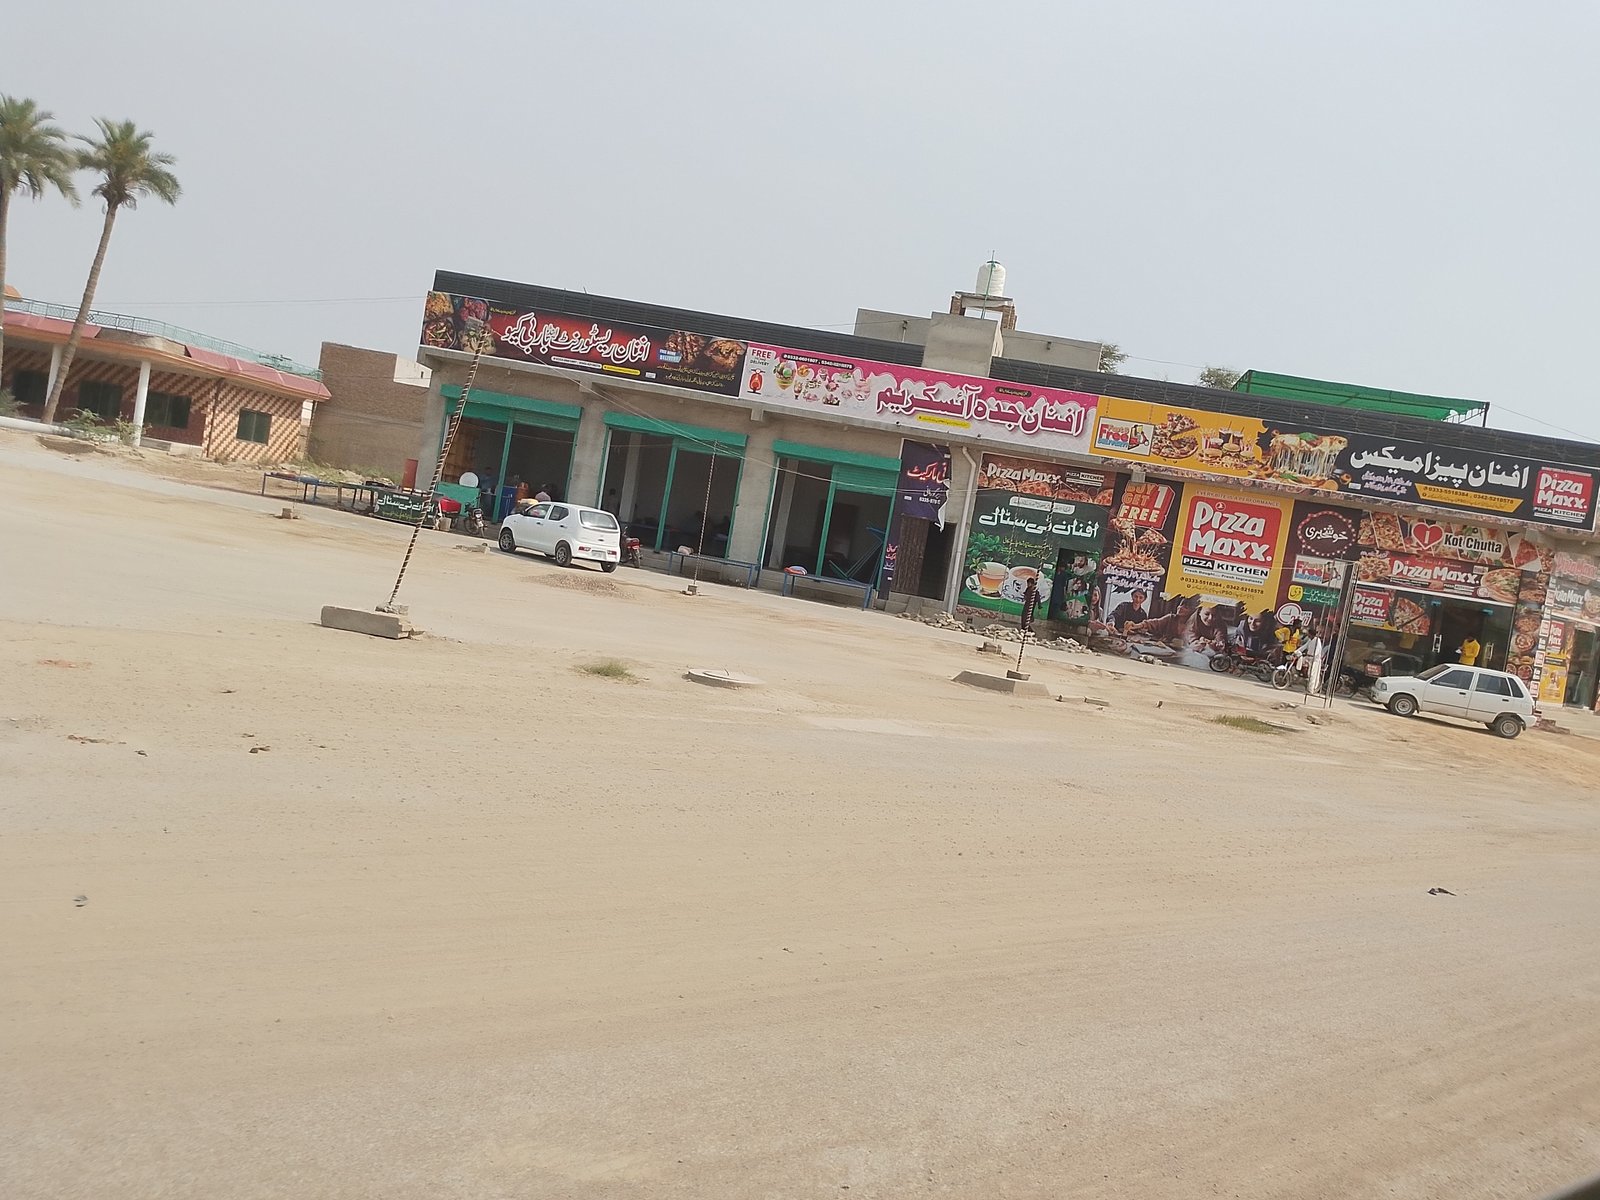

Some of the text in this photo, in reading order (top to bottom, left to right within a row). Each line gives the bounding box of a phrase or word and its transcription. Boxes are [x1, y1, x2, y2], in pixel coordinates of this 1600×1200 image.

[611, 336, 650, 364] افنان
[752, 349, 772, 359] FREE
[1020, 402, 1085, 437] افنان
[987, 462, 1020, 481] Pizza
[1080, 473, 1104, 481] KITCHEN
[1468, 461, 1529, 489] افنان
[1539, 473, 1583, 494] Pizza
[1123, 492, 1150, 507] GET
[1127, 483, 1168, 509] BUY 1
[1119, 505, 1160, 522] FREE
[1193, 501, 1265, 537] Pizza
[1554, 510, 1586, 519] KITCHEN
[1052, 519, 1100, 538] افنان
[1444, 534, 1463, 547] Kot
[1466, 537, 1502, 553] Chutta
[1183, 557, 1268, 577] PIZZA KITCHEN
[1392, 560, 1432, 579] Pizza
[1353, 593, 1383, 607] Pizza
